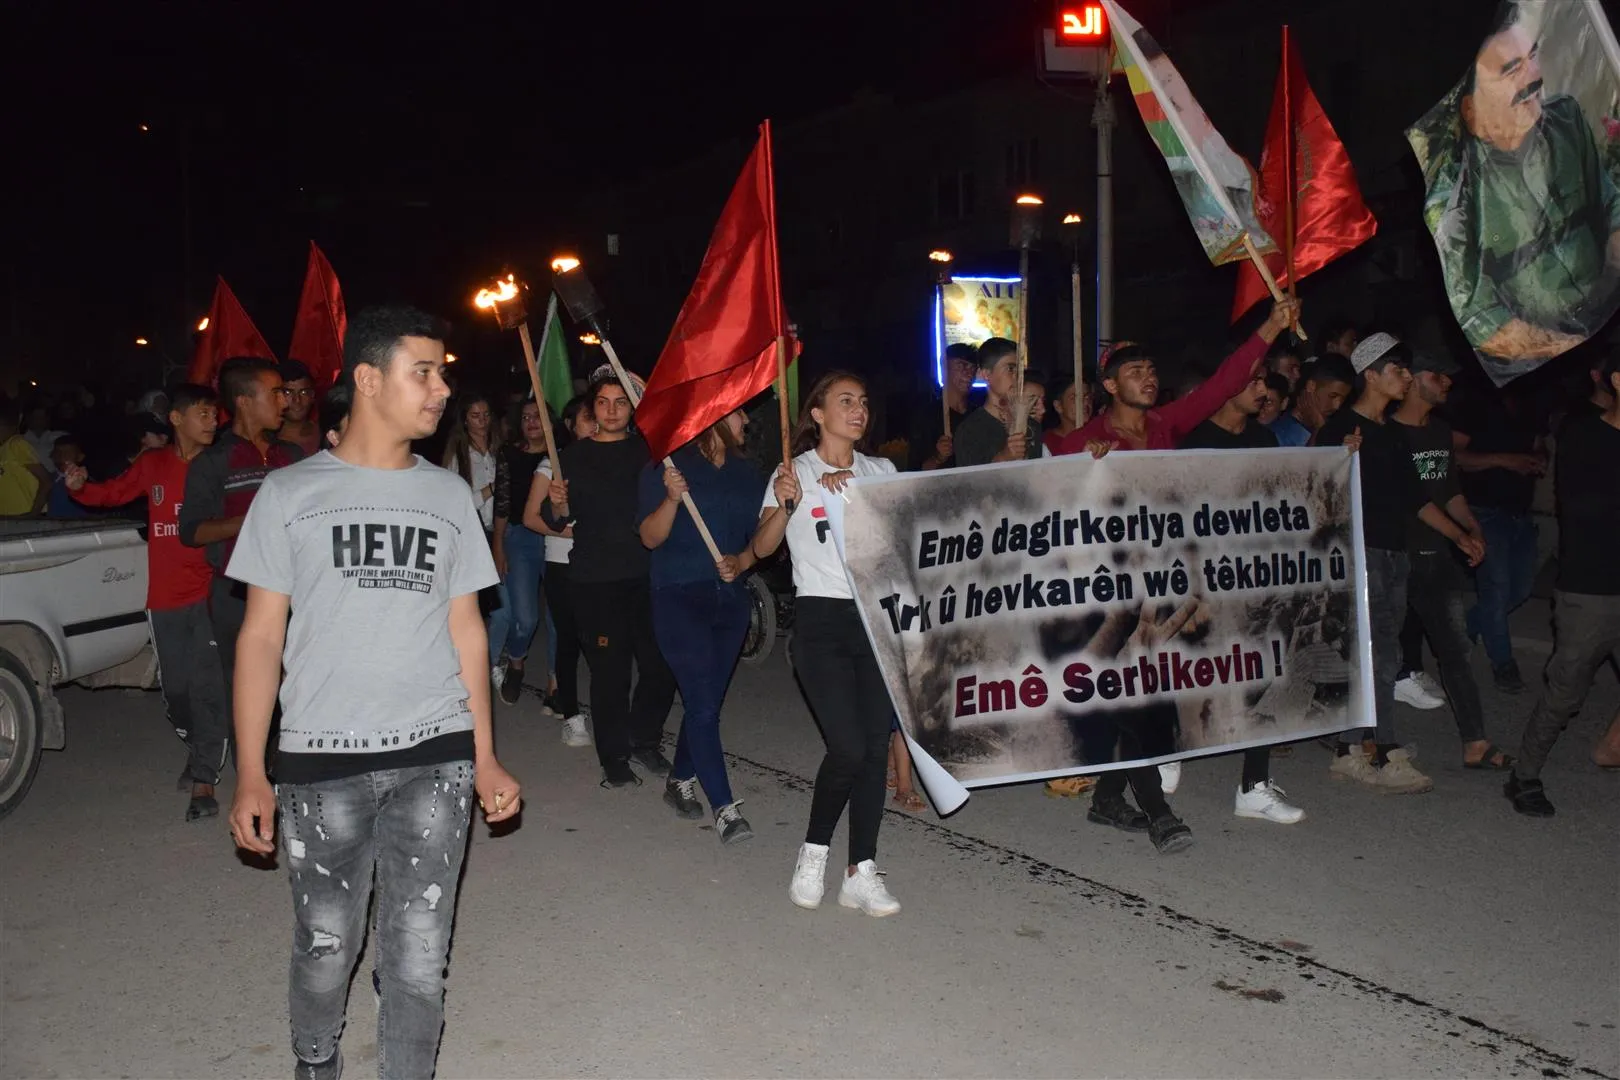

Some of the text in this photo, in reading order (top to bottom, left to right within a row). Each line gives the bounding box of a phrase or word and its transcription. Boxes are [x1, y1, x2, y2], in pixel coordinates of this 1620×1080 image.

[1420, 471, 1448, 481] RIDAY
[1427, 461, 1436, 469] IS
[918, 499, 1310, 569] Emê dagirkeriya dewleta
[332, 523, 438, 572] HEVE
[377, 579, 394, 587] TIME
[395, 580, 411, 589] WILL
[411, 583, 430, 592] AWAY
[380, 569, 405, 578] WHILE
[407, 571, 425, 581] TIME
[427, 574, 433, 583] IS
[879, 546, 1345, 634] Trk û hevkarên wê têkbibin û
[954, 639, 1282, 718] Emê Serbikevin !
[308, 726, 441, 748] NO PAIN NO GAIN
